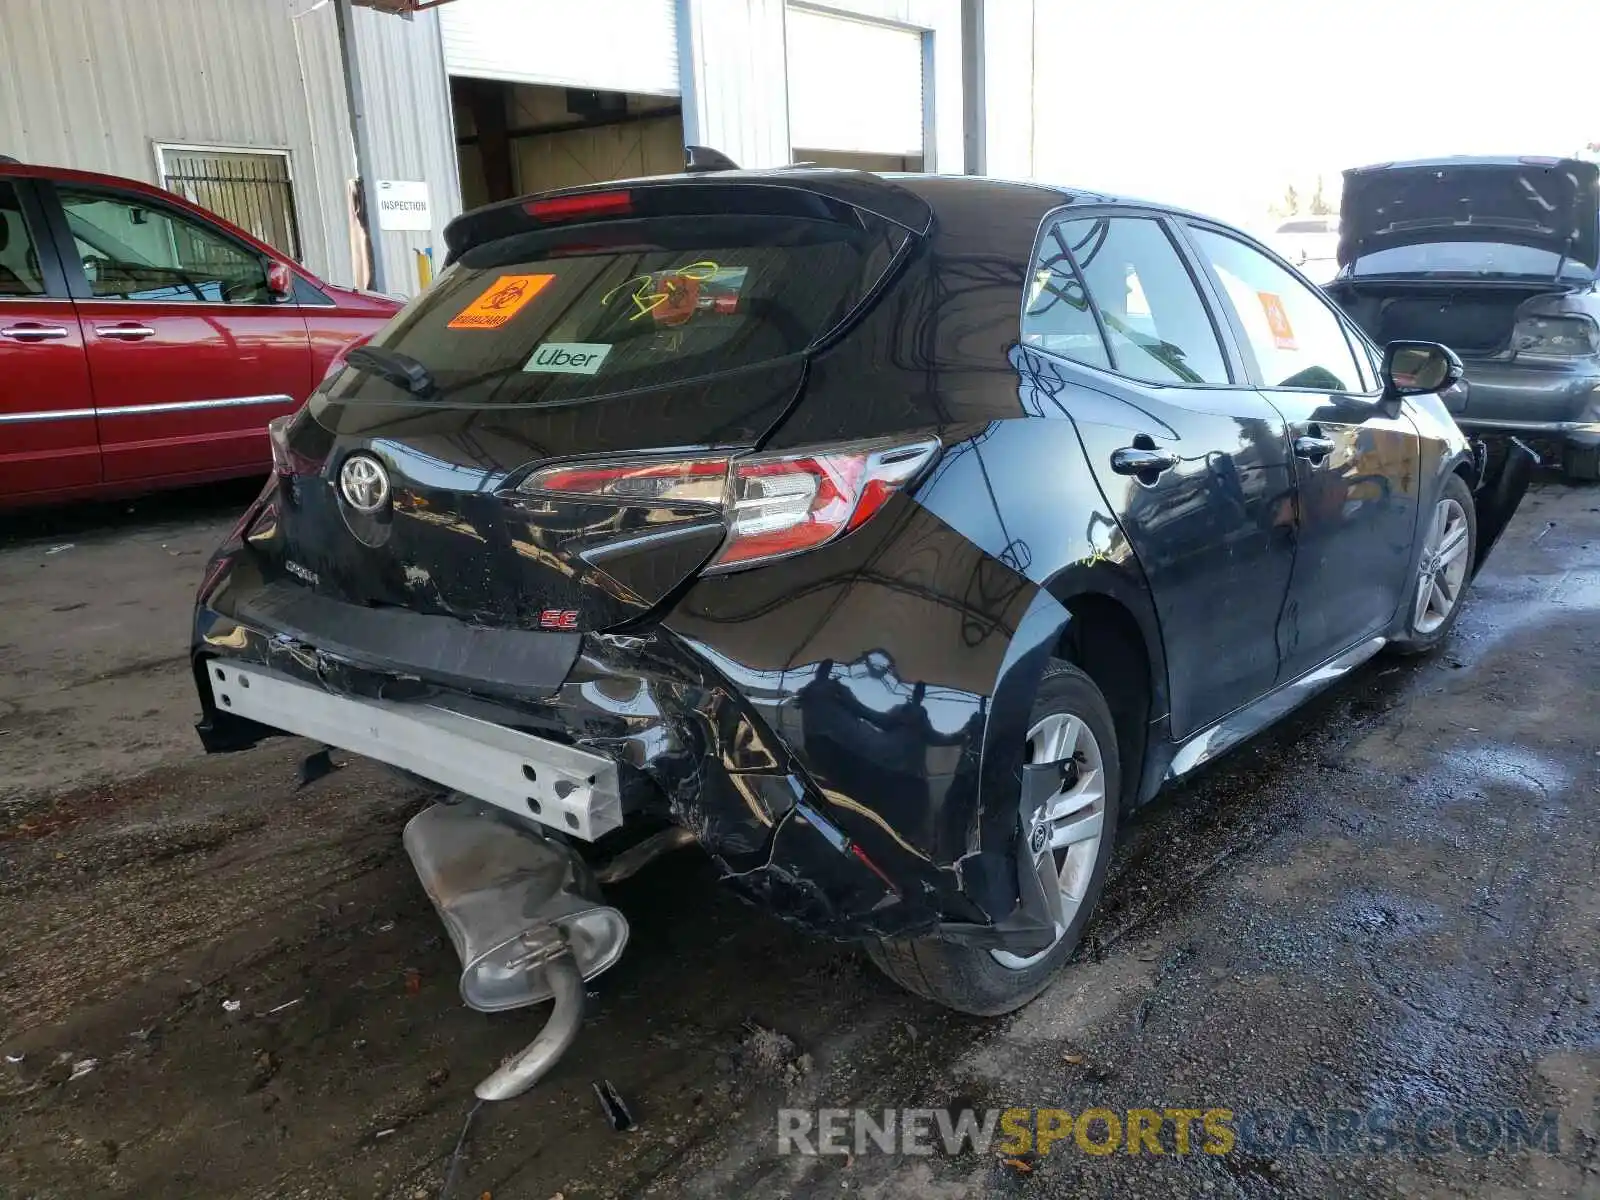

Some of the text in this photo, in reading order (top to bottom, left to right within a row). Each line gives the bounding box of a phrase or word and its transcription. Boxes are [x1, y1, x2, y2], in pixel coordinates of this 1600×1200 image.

[381, 200, 426, 211] INSPECTION
[536, 349, 598, 366] Uber
[541, 610, 578, 628] SE
